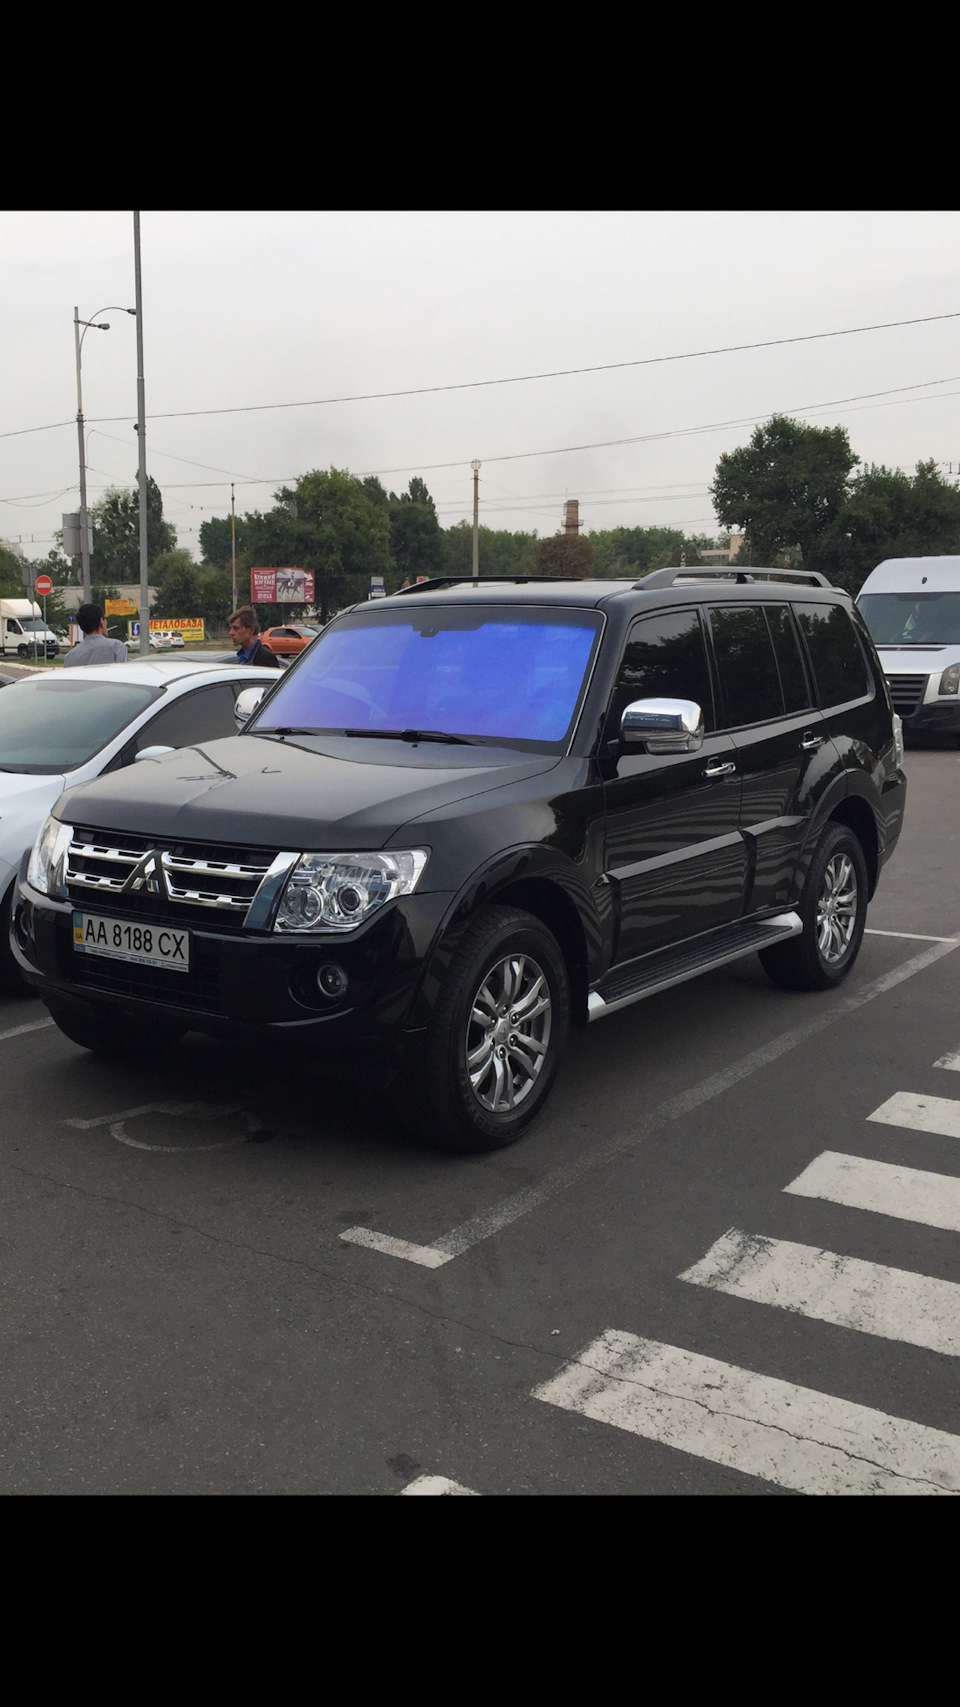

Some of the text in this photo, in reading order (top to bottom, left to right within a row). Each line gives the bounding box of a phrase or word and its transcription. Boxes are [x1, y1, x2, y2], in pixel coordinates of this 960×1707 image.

[85, 919, 185, 960] AA 8188 CX
